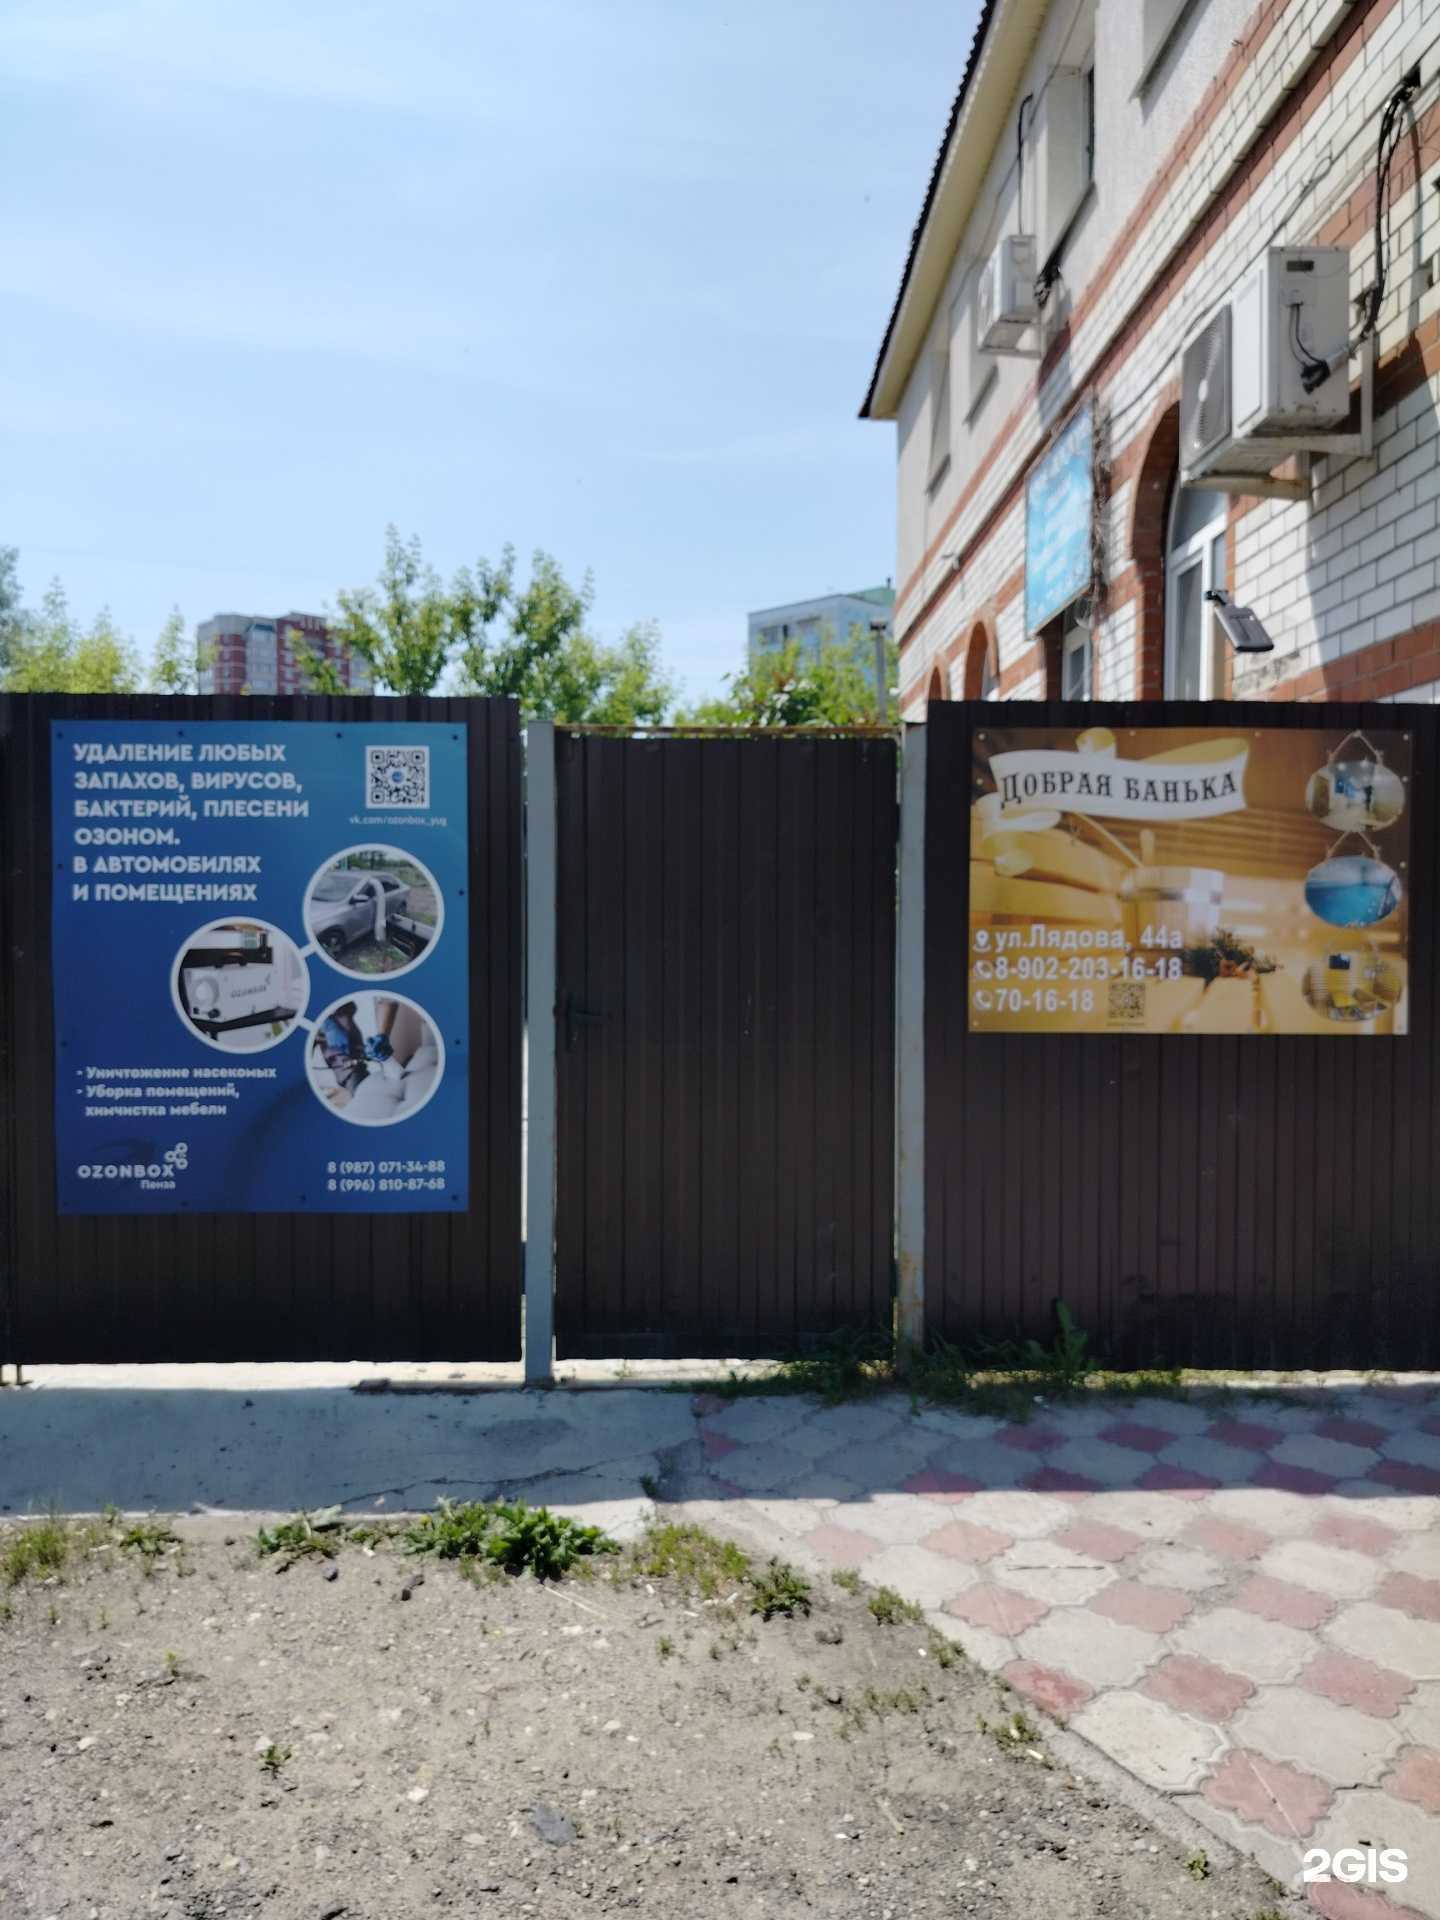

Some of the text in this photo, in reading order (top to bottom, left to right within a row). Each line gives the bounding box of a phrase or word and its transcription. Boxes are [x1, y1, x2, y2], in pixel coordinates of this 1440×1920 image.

[73, 743, 287, 764] УДАЛЕНИЕ ЛЮБЫХ
[74, 772, 303, 793] ЗАПАХОВ, ВИРУСОВ,
[1000, 770, 1237, 809] ДОБРАЯ БАНЬКА
[74, 795, 310, 820] БАКТЕРИЙ, ПЛЕСЕНИ
[74, 828, 181, 846] ОЗОНОМ.
[73, 856, 262, 874] В АВТОМОБИЛЯХ
[73, 884, 258, 905] И ПОМЕЩЕНИЯХ
[1139, 925, 1184, 950] 44а
[994, 956, 1184, 981] 8-902-203-16-18
[994, 988, 1095, 1013] 70-16-18
[86, 1066, 277, 1079] Уничтожение насекомых
[86, 1083, 240, 1100] Уборка помещений,
[85, 1101, 227, 1117] химчистка мебели
[77, 1164, 175, 1179] OZONBOX
[327, 1160, 445, 1175] 8 (987) 071-34-88
[141, 1179, 176, 1190] Пенза
[327, 1178, 445, 1193] 8 (996) 810-87-68
